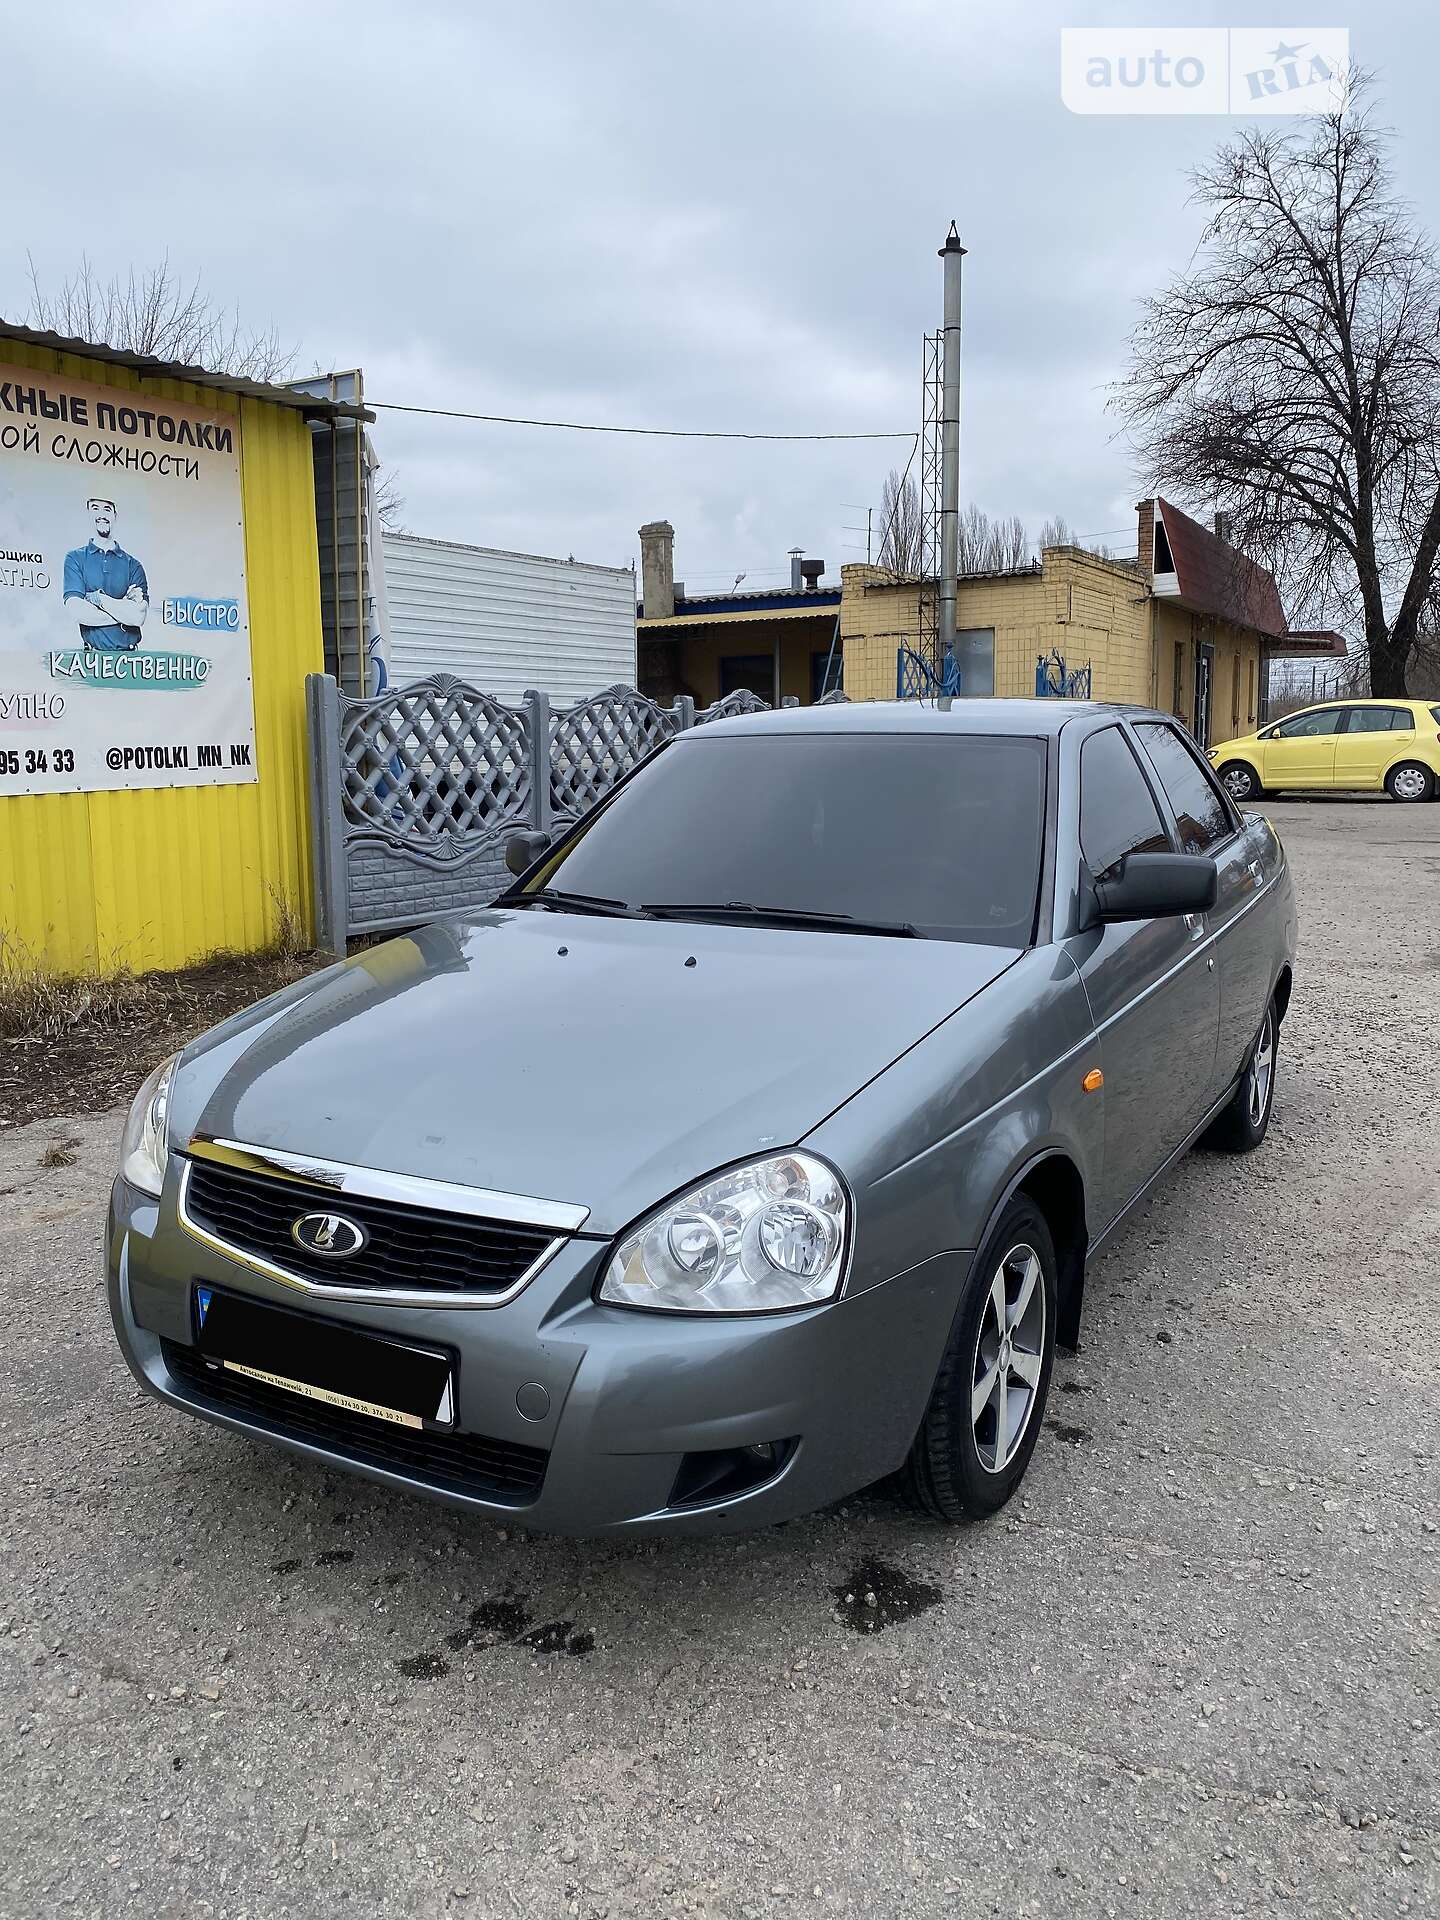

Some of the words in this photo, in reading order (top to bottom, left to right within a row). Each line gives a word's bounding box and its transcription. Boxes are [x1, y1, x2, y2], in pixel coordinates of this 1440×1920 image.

[96, 402, 233, 454] ПОТОЛКИ
[1, 422, 40, 454] ОЙ
[51, 434, 200, 481] СЛОЖНОСТИ
[161, 599, 240, 627] БЫСТРО
[49, 651, 210, 681] КАЧЕСТВЕННО
[25, 749, 48, 774] 34
[53, 748, 75, 773] 33
[105, 744, 251, 772] @POTOLKI_MN_NK
